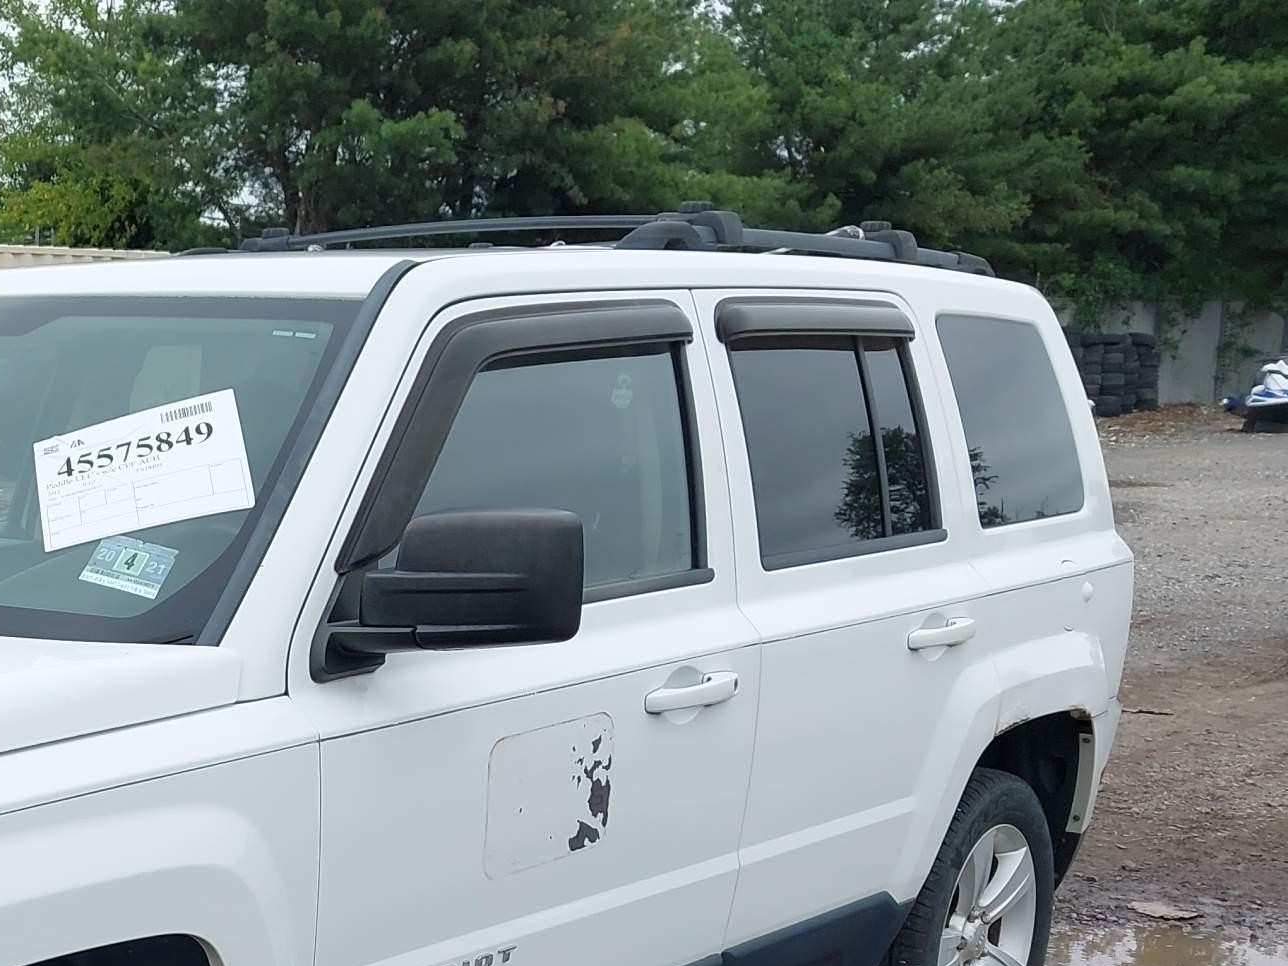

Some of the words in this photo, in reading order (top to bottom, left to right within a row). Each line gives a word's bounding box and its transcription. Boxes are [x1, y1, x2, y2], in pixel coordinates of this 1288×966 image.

[57, 421, 214, 477] 45575849
[96, 548, 116, 562] 20
[123, 552, 139, 571] 4
[145, 561, 166, 575] 21
